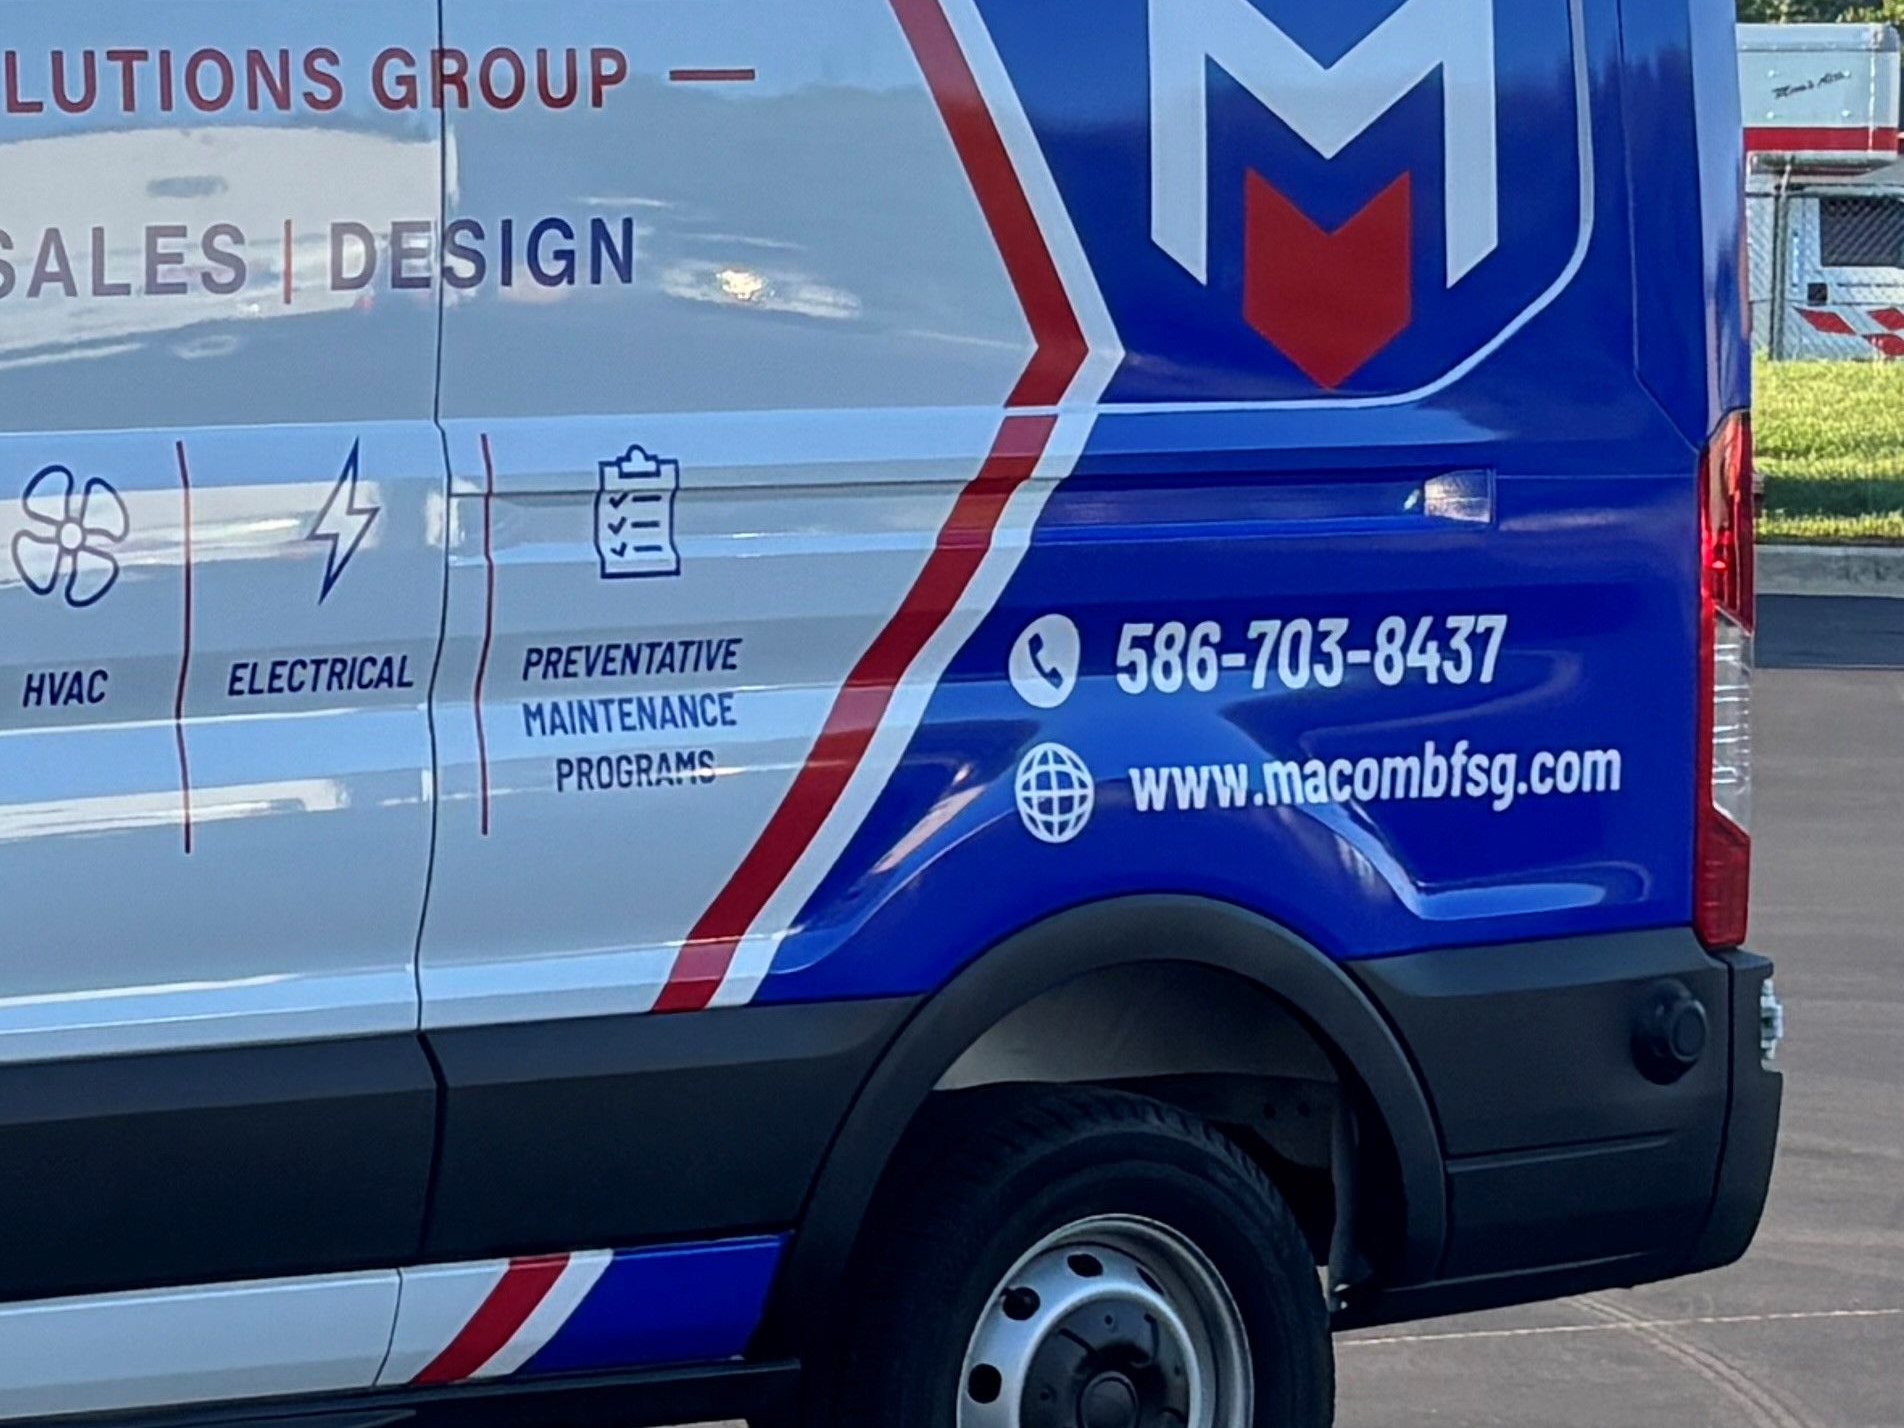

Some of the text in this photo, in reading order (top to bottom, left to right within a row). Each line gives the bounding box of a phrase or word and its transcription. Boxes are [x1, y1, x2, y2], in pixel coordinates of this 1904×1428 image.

[372, 47, 629, 109] GROUP
[327, 217, 635, 294] DESIGN
[226, 654, 414, 697] ELECTRICAL
[521, 637, 742, 681] PREVENTATIVE
[1115, 614, 1508, 696] 586-703-8437
[21, 669, 110, 708] HVAC
[521, 692, 739, 735] MAINTENANCE
[553, 749, 717, 792] PROGRAMS
[1129, 740, 1622, 812] www.macombfsg.com
